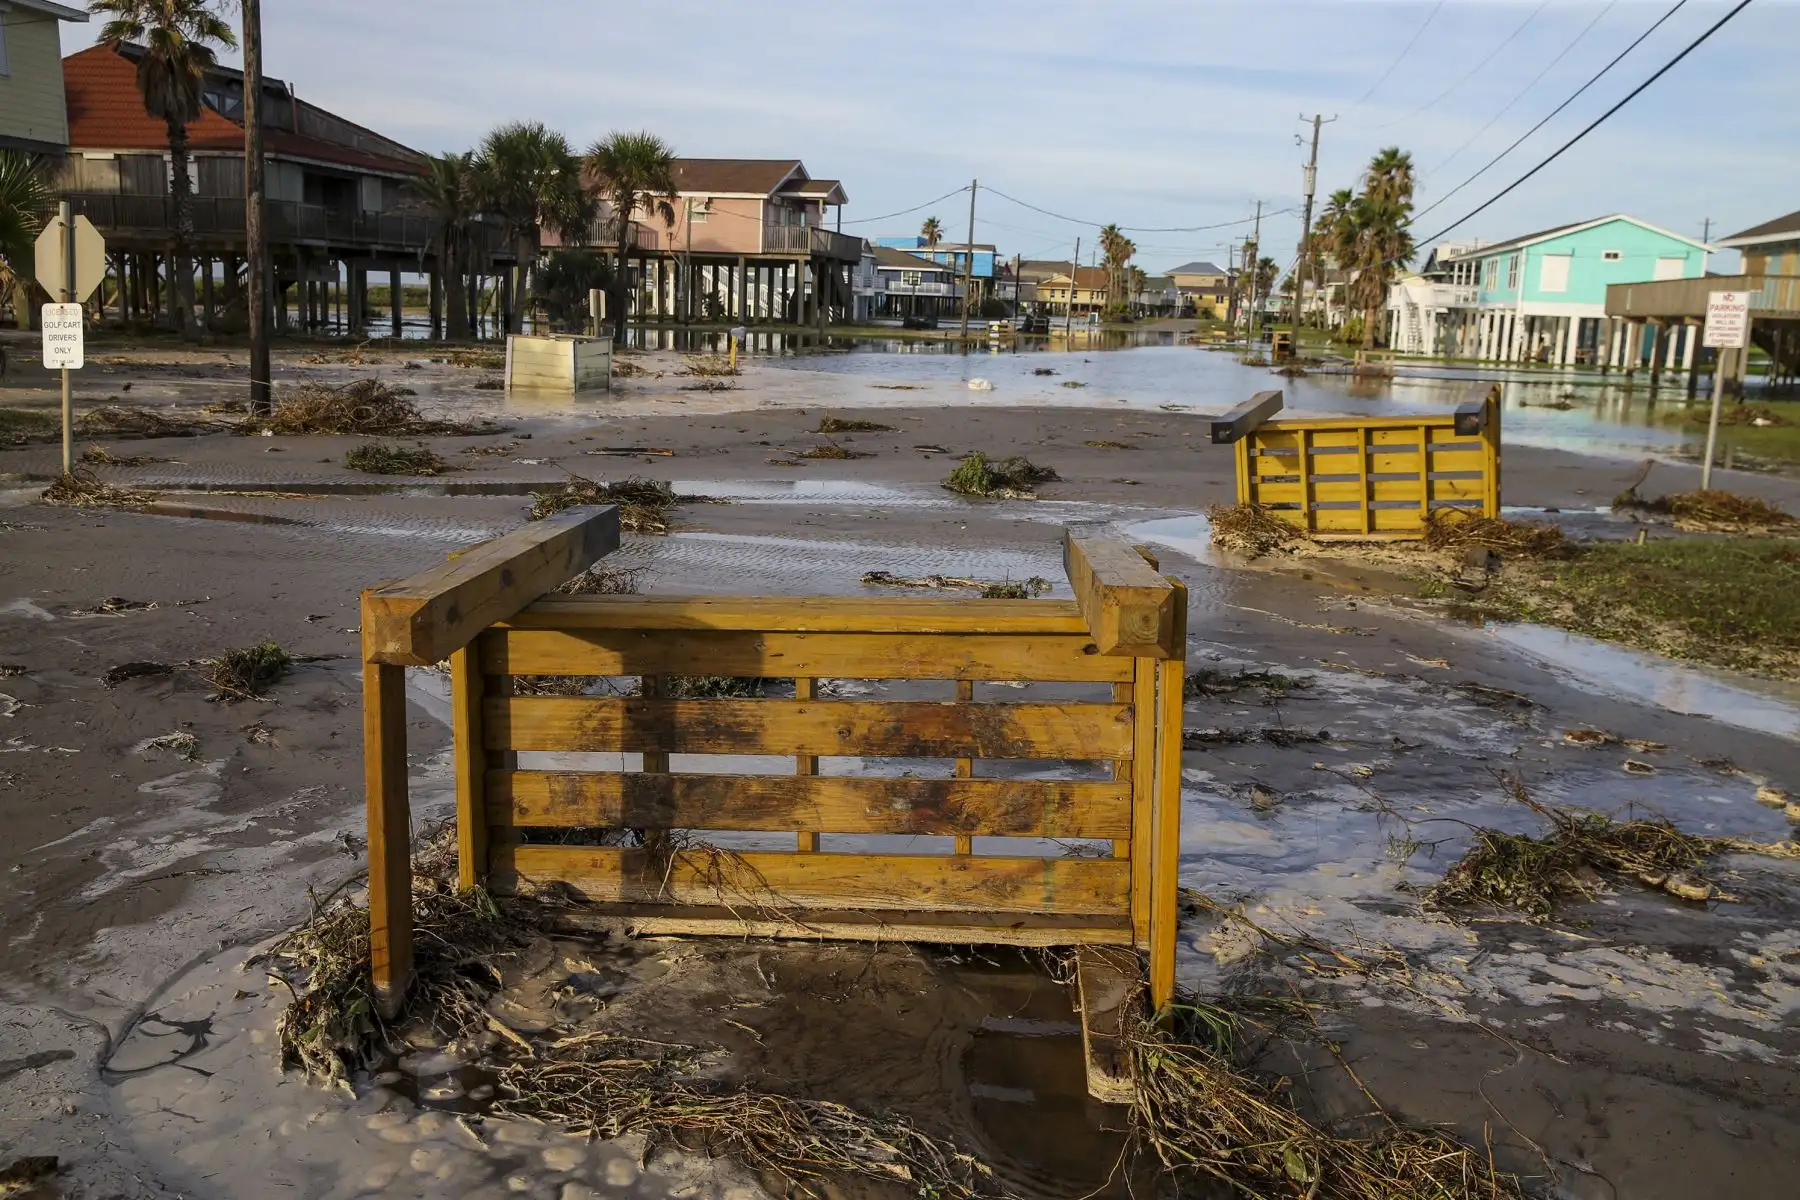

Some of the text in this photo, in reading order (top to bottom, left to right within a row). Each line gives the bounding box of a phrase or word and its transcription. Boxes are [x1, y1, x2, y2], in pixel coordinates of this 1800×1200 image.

[1723, 294, 1735, 302] NO
[44, 321, 81, 329] GOLF CART
